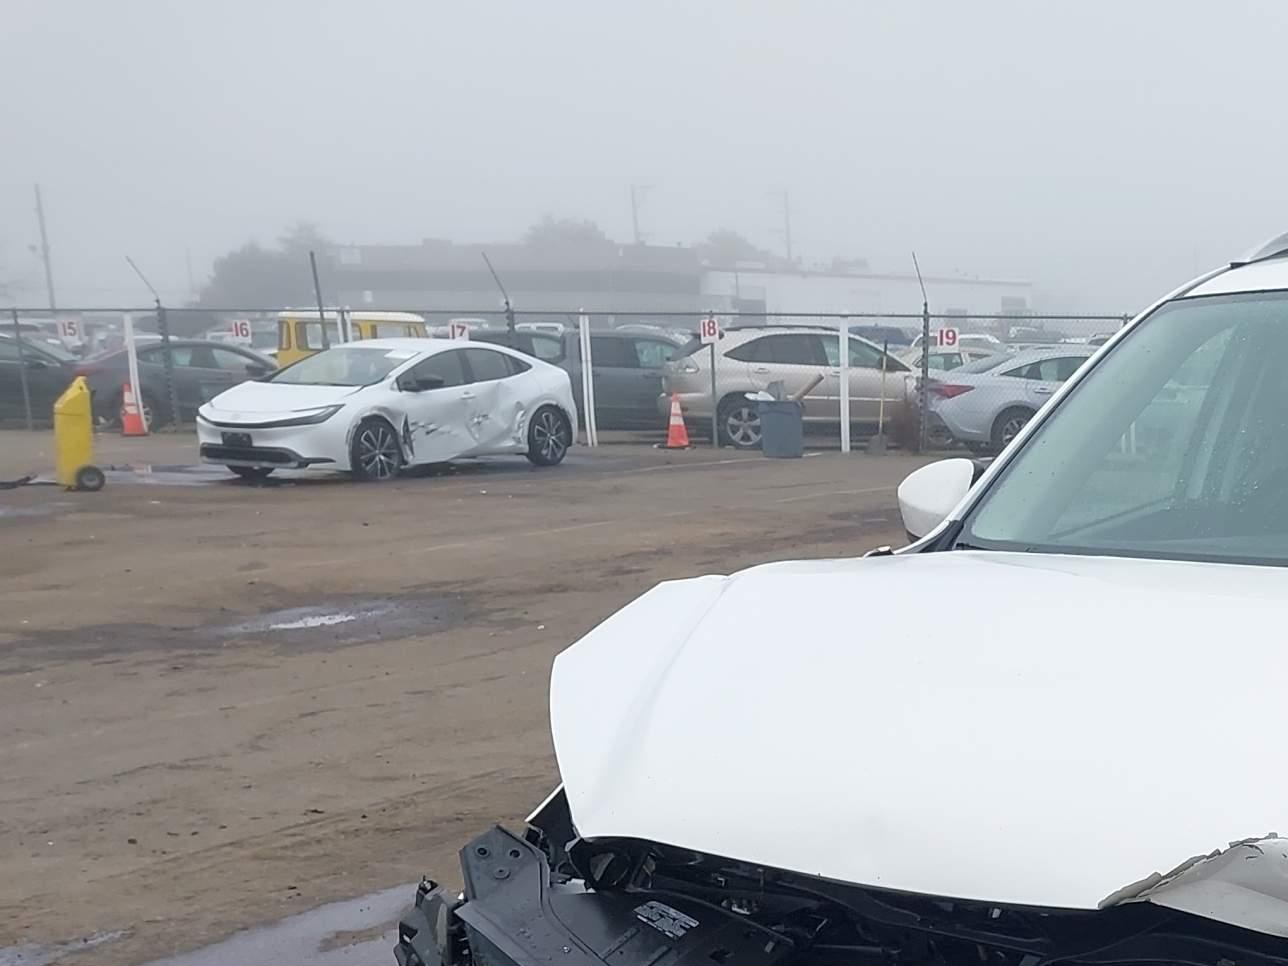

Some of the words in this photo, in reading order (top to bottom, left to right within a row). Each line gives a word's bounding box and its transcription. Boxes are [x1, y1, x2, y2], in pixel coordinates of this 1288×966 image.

[62, 321, 78, 338] 15
[233, 321, 250, 337] 16
[450, 324, 467, 340] 17
[702, 319, 717, 339] 18
[938, 329, 957, 346] 19
